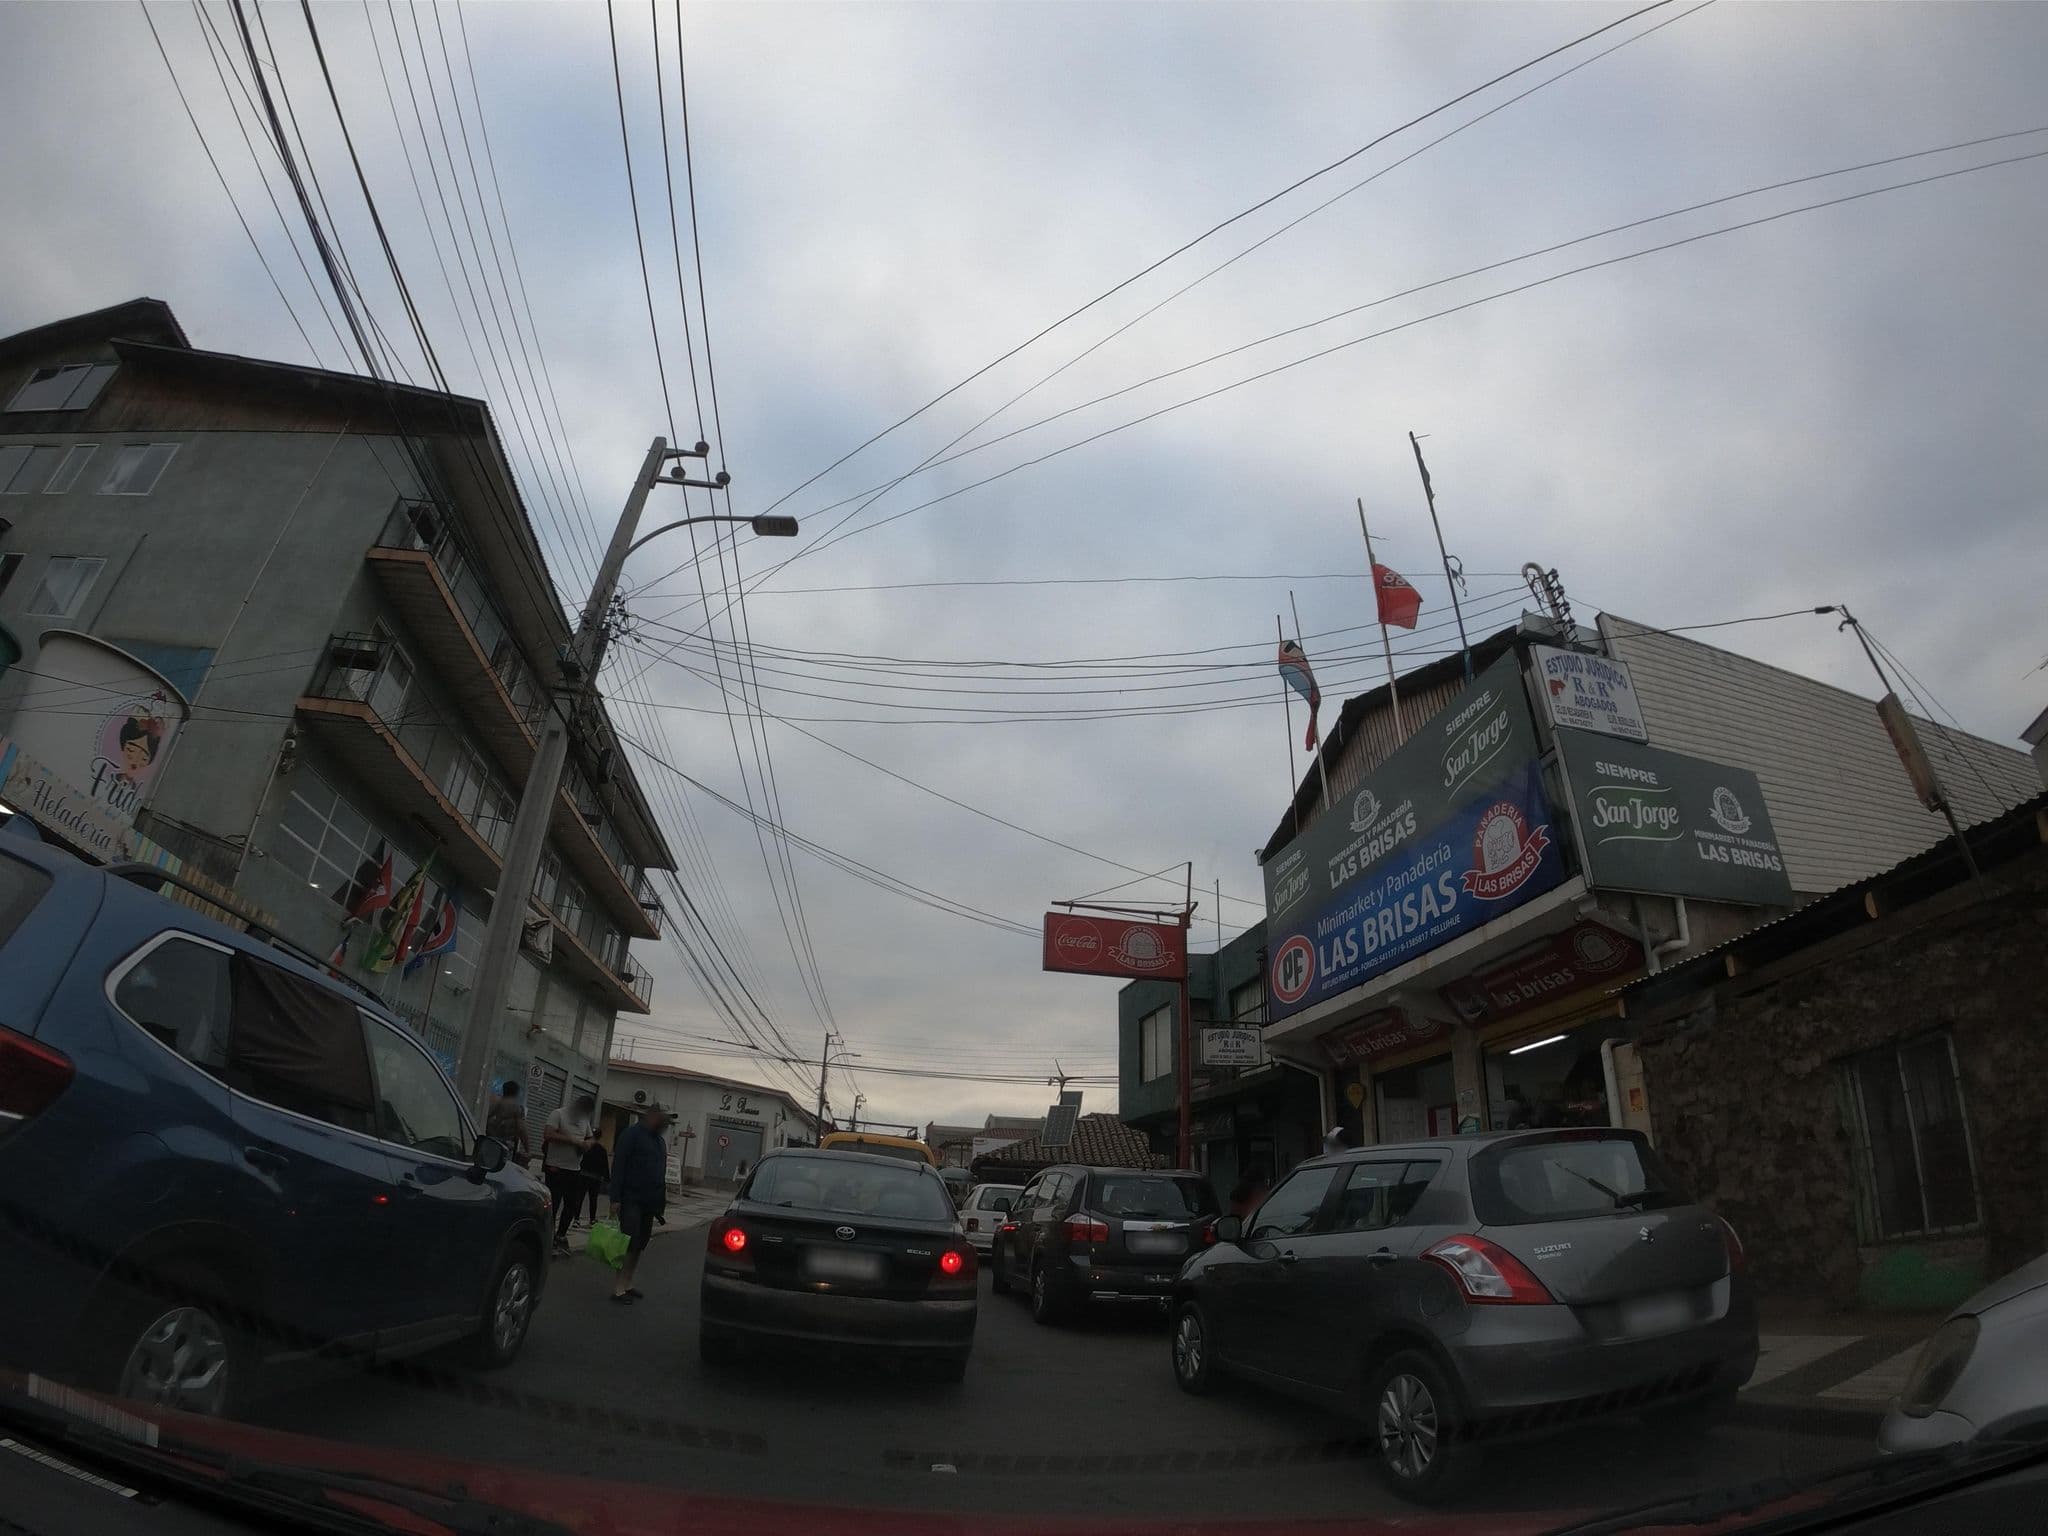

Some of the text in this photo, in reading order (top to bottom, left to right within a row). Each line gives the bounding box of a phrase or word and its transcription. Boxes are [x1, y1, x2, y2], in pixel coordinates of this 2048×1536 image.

[1546, 655, 1583, 674] ESTUDIO
[1446, 690, 1492, 735] SIEMPRE
[1574, 695, 1618, 712] ABOGADOS
[1444, 710, 1508, 788] San Jorge
[1595, 761, 1658, 785] SIEMPRE
[1592, 796, 1631, 828] San
[1629, 797, 1680, 830] Jorge
[1275, 849, 1303, 875] SIEMPRE
[1329, 812, 1416, 890] LAS BRISAS
[1697, 842, 1783, 872] LAS BRISAS
[1478, 851, 1535, 893] LAS BRISAS
[1272, 867, 1310, 913] San Jorge
[1317, 843, 1452, 939] Minimarket y Panadería
[1319, 870, 1457, 977] LAS BRISAS
[1430, 913, 1461, 936] PELLUHUE
[1120, 955, 1164, 968] LAS BRISAS
[1281, 947, 1304, 988] PF
[1490, 988, 1521, 1009] las
[1519, 967, 1575, 999] brisas
[1207, 1031, 1230, 1042] ESTUDIO
[1350, 1029, 1406, 1057] las brisas
[1533, 1242, 1572, 1254] SUZUKI
